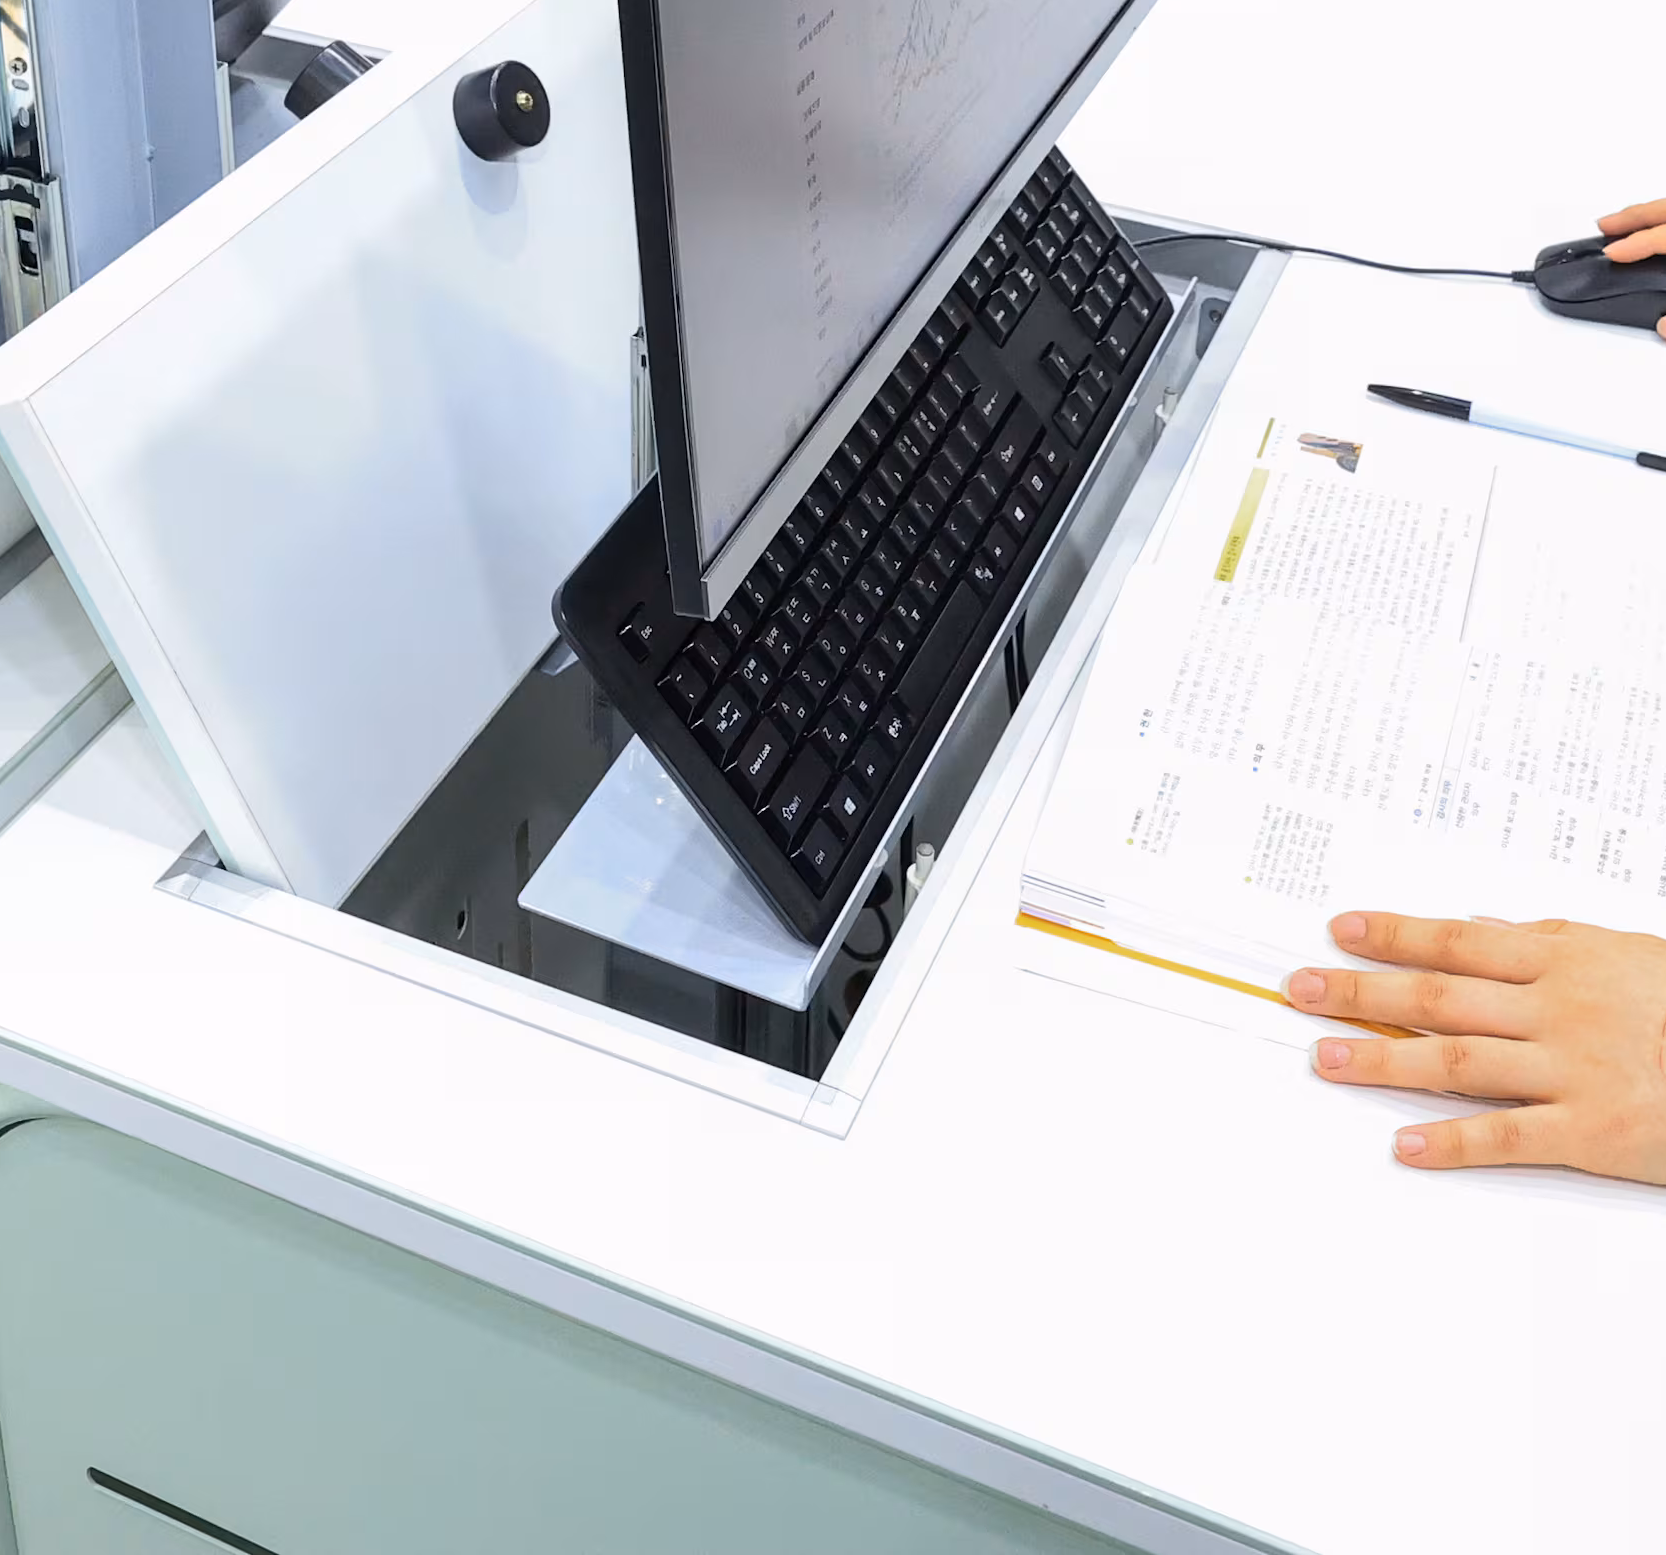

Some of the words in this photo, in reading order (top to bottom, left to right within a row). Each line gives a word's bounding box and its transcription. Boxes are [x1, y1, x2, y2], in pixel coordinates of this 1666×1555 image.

[870, 429, 879, 439] 9
[834, 480, 842, 490] 7
[815, 507, 824, 517] 6
[845, 519, 853, 530] Y
[795, 534, 805, 545] 5
[777, 563, 785, 573] 4
[806, 577, 815, 587] R
[861, 579, 869, 591] G
[755, 593, 765, 603] 3
[786, 606, 795, 617] E
[641, 625, 653, 639] Esc
[733, 623, 742, 634] 2
[822, 639, 831, 651] D
[743, 667, 753, 679] Q
[863, 663, 871, 675] C
[801, 671, 811, 681] S
[843, 694, 852, 707] X
[781, 702, 790, 713] A
[717, 719, 727, 733] Tab
[888, 718, 903, 739] 한자
[823, 727, 832, 739] Z
[749, 757, 763, 775] Caps
[759, 744, 772, 761] Lock
[867, 765, 875, 777] Alt
[790, 795, 801, 813] Shift
[815, 850, 825, 865] Ctrl
